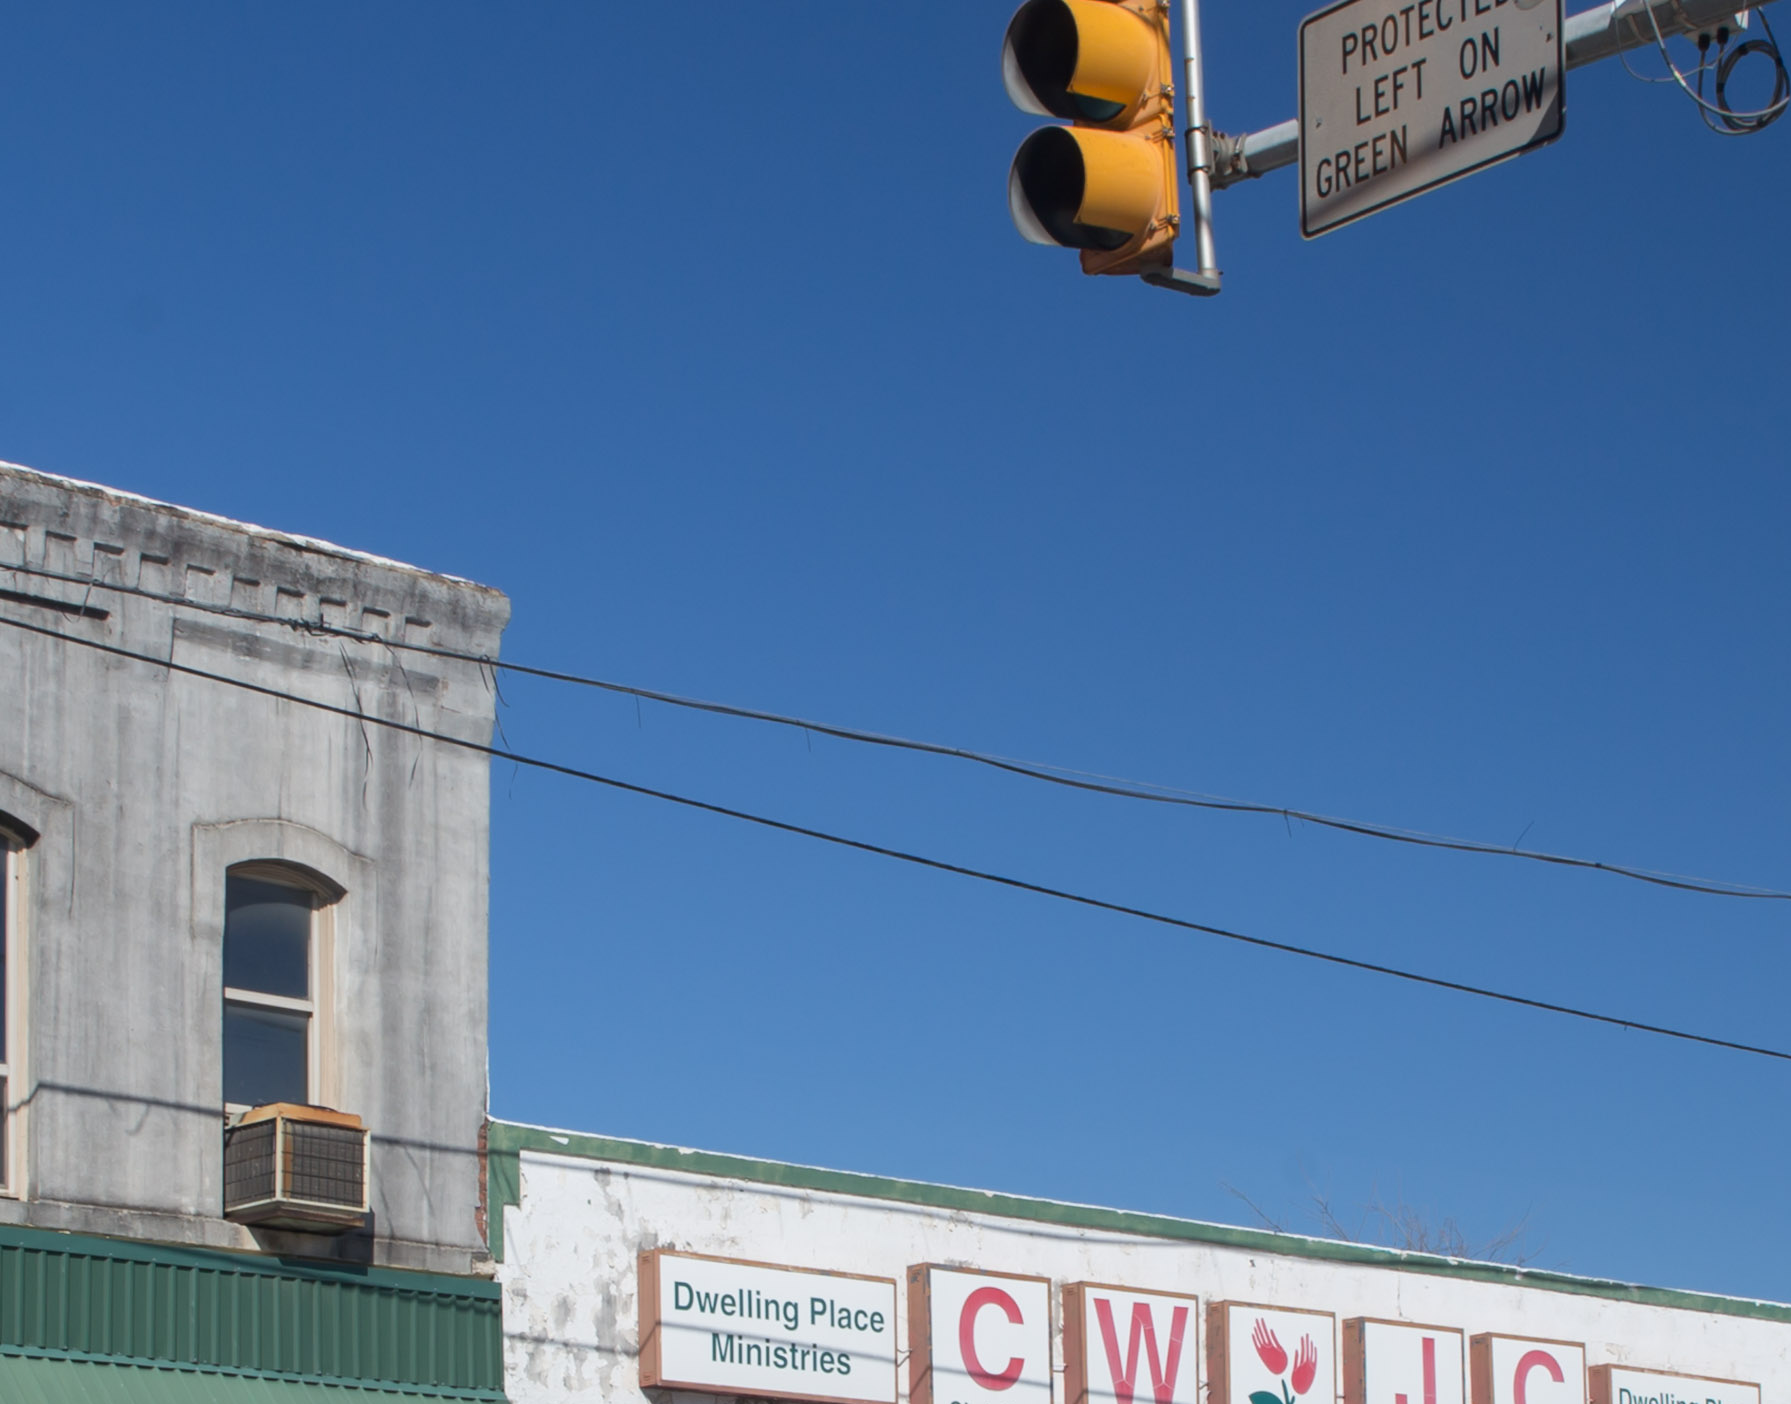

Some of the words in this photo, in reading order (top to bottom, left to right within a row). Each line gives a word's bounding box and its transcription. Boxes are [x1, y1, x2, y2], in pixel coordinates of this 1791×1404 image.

[1342, 0, 1511, 75] PROTEC
[1356, 58, 1427, 126] LEFT
[1460, 26, 1500, 80] ON
[1316, 124, 1407, 198] GREEN
[1439, 66, 1546, 149] ARROW
[674, 1281, 799, 1331] Dwelling
[810, 1297, 885, 1333] Place
[958, 1286, 1025, 1391] C
[711, 1332, 851, 1375] Ministries
